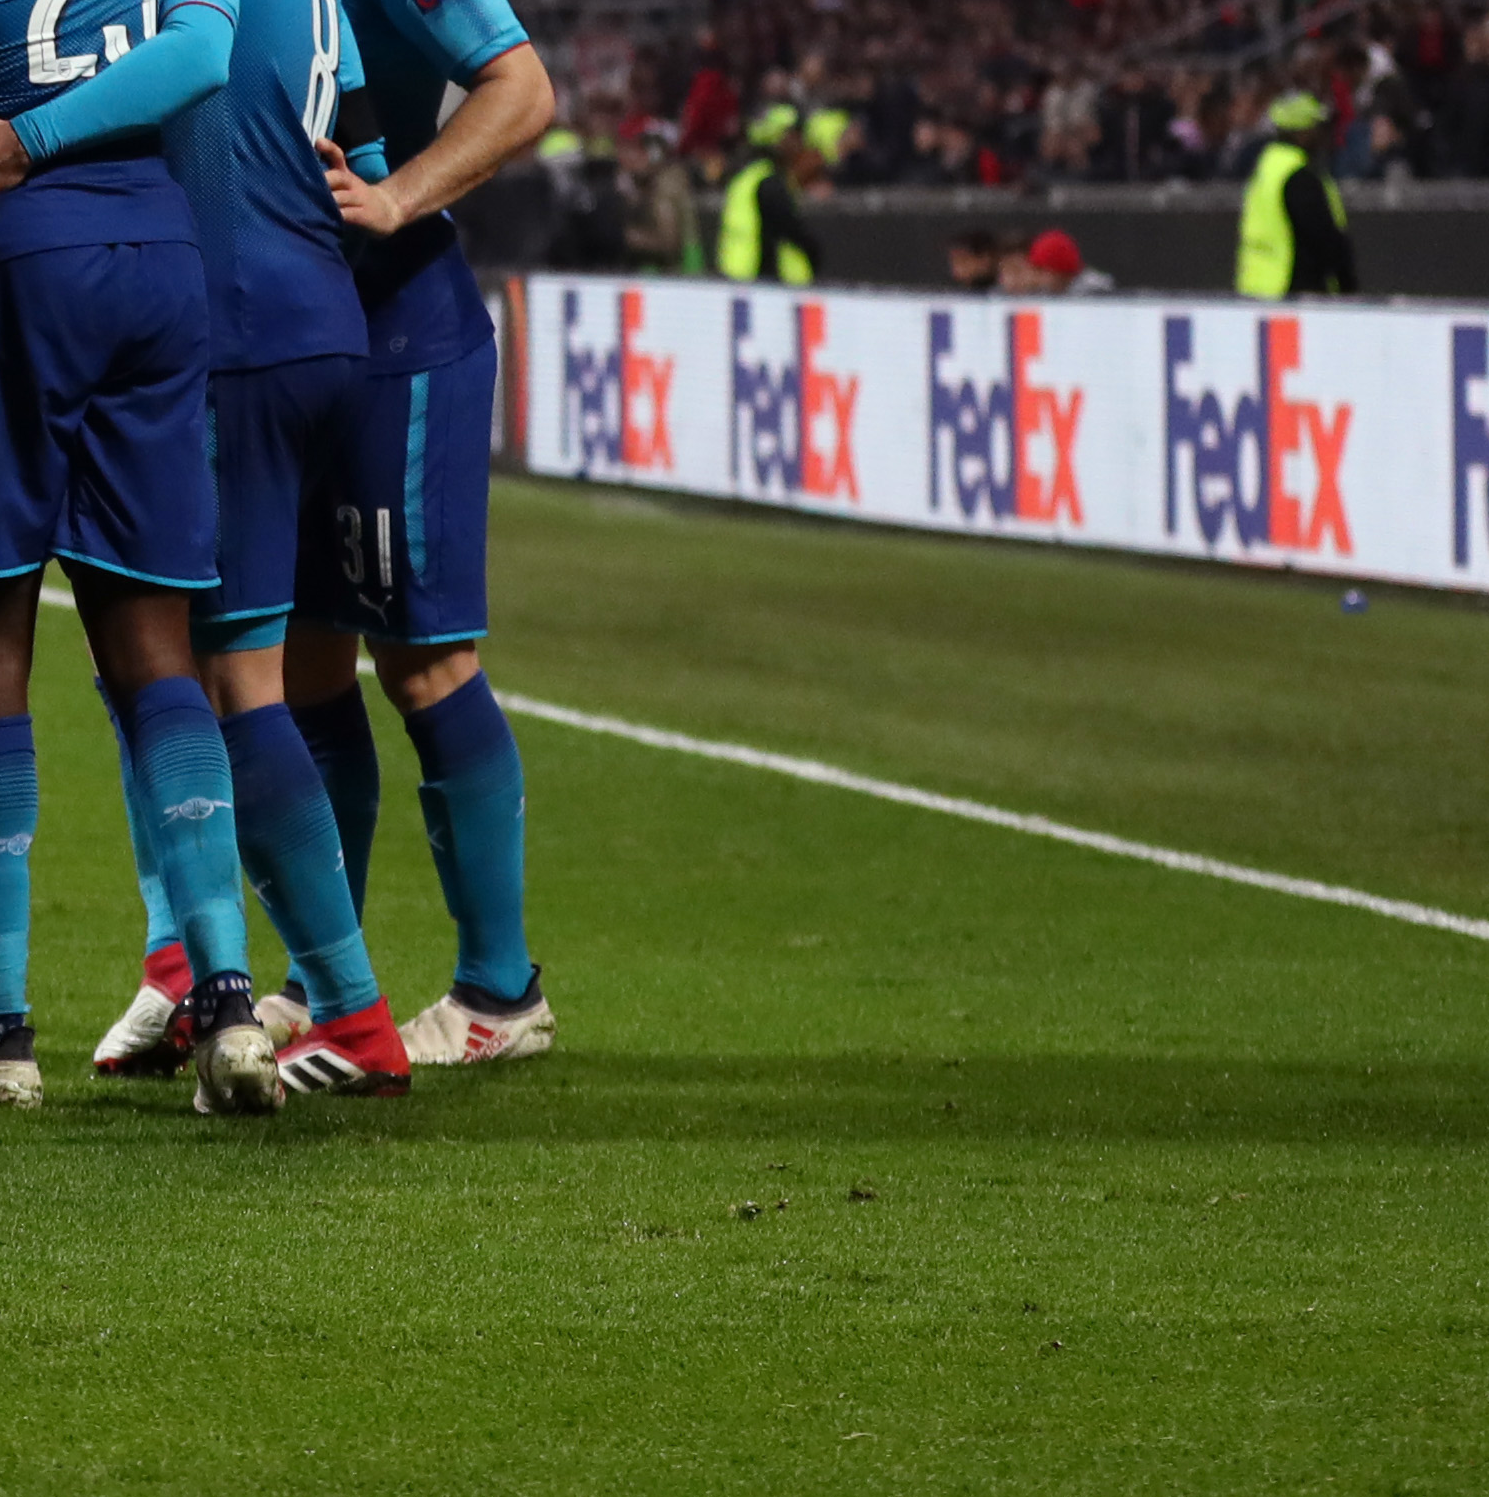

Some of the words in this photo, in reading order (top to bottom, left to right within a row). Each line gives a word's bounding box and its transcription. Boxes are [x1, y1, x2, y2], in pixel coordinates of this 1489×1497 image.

[562, 288, 674, 478] FedEx
[730, 296, 859, 503] FedEx
[929, 309, 1085, 528] FedEx
[1164, 314, 1353, 556] FedEx
[336, 504, 393, 587] 31
